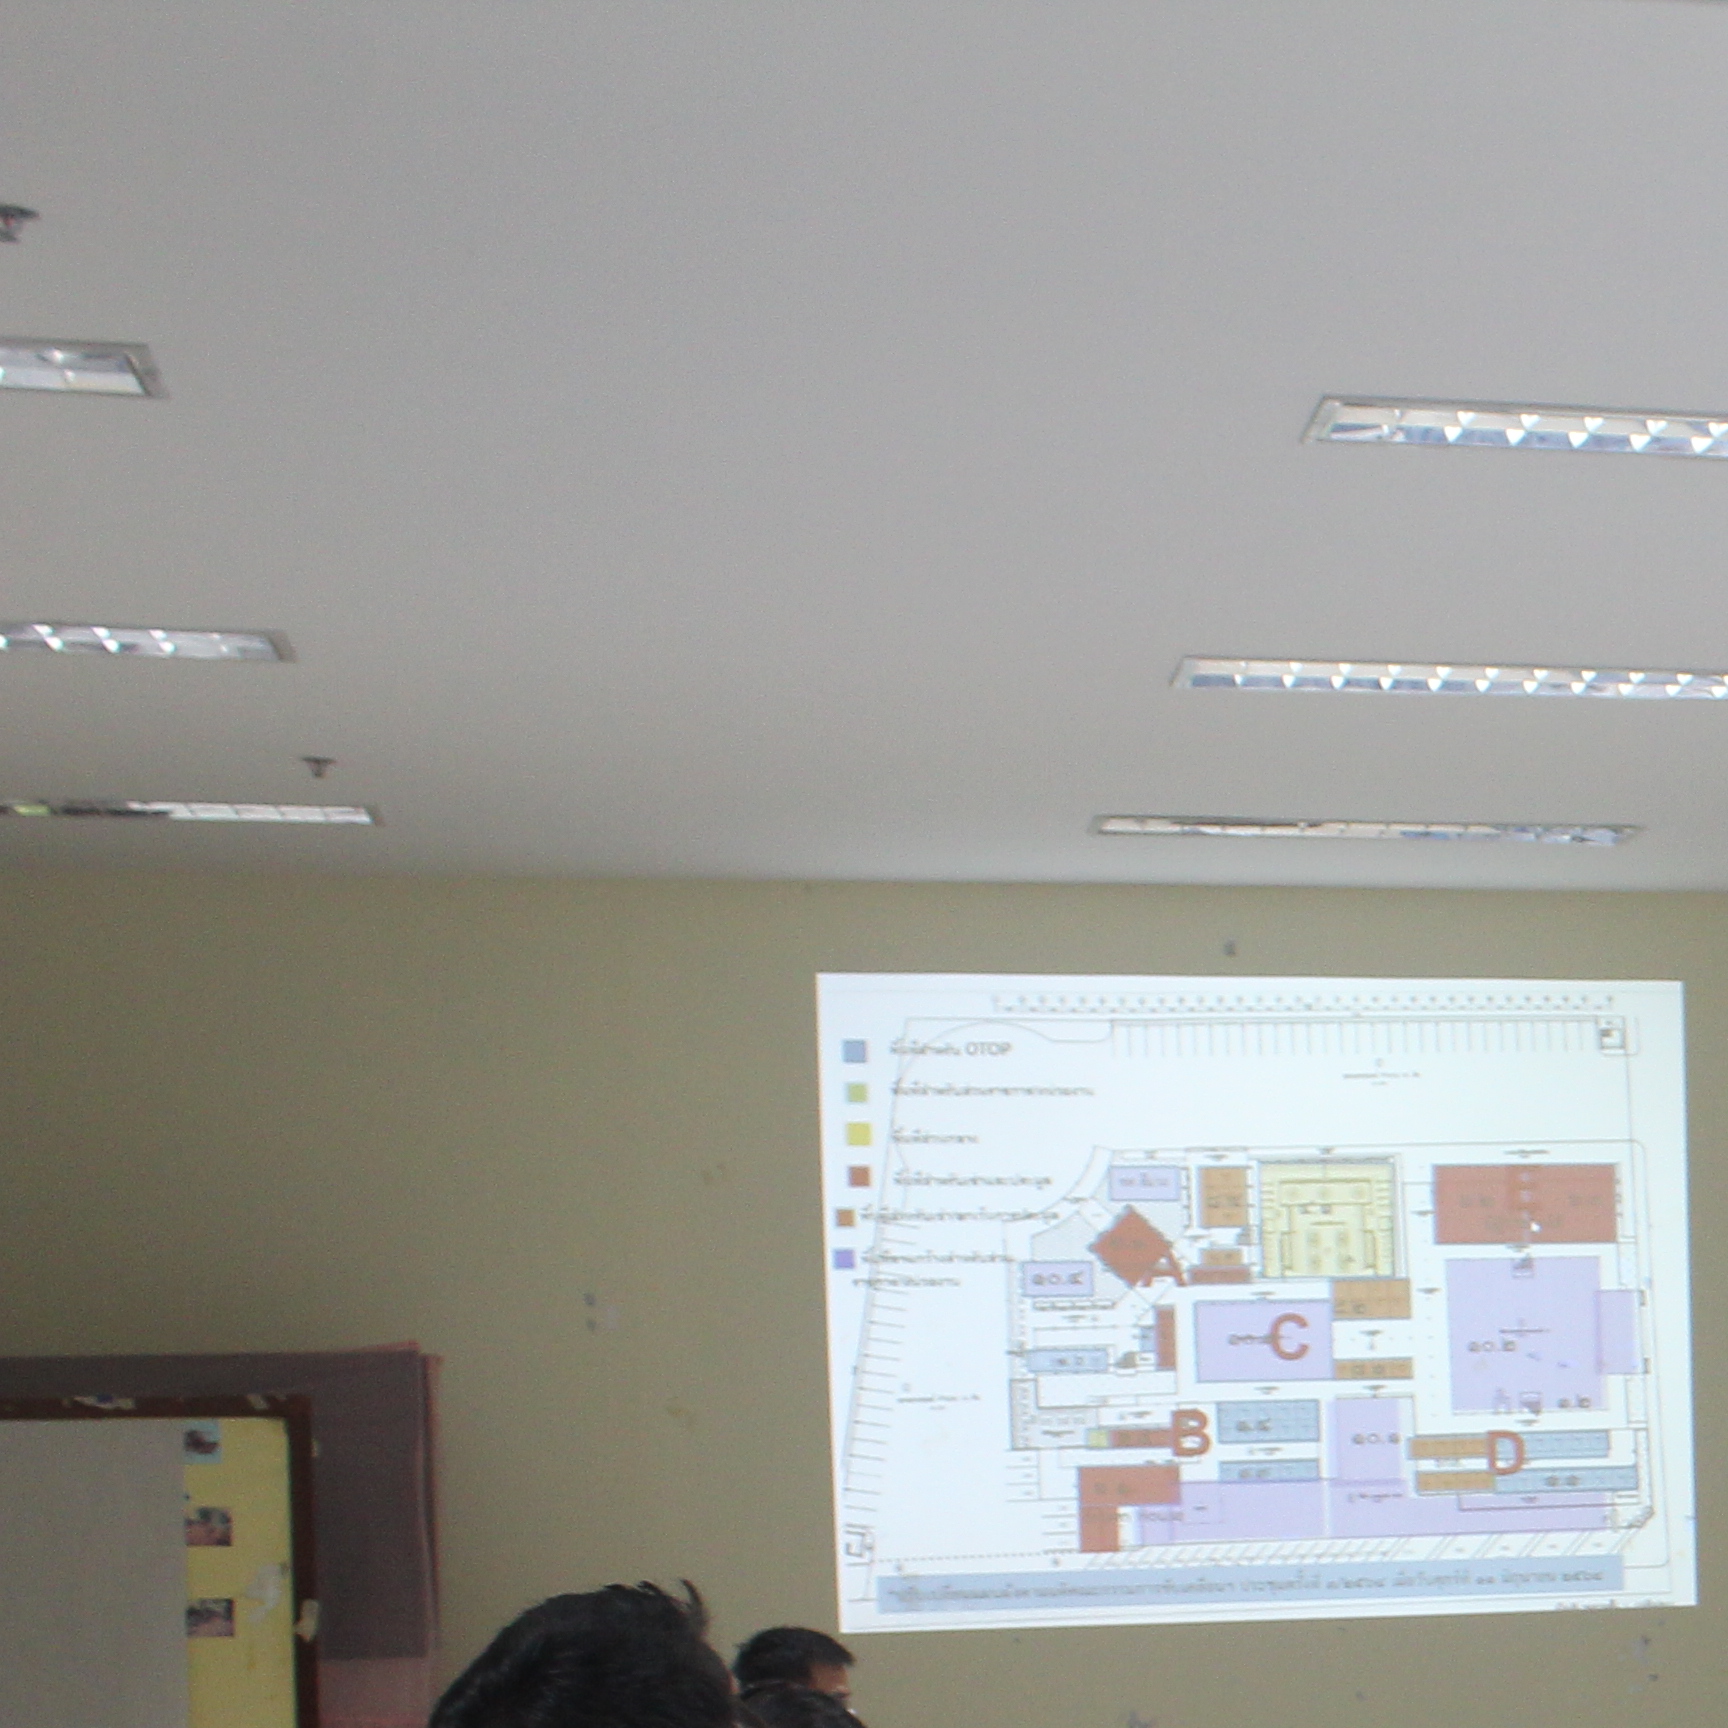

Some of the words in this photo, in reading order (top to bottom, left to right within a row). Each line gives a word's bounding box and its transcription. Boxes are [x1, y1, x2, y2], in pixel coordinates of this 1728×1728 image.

[965, 1041, 1012, 1055] OTOP
[1271, 1313, 1311, 1361] C
[1171, 1408, 1211, 1457] B
[1487, 1430, 1525, 1475] D
